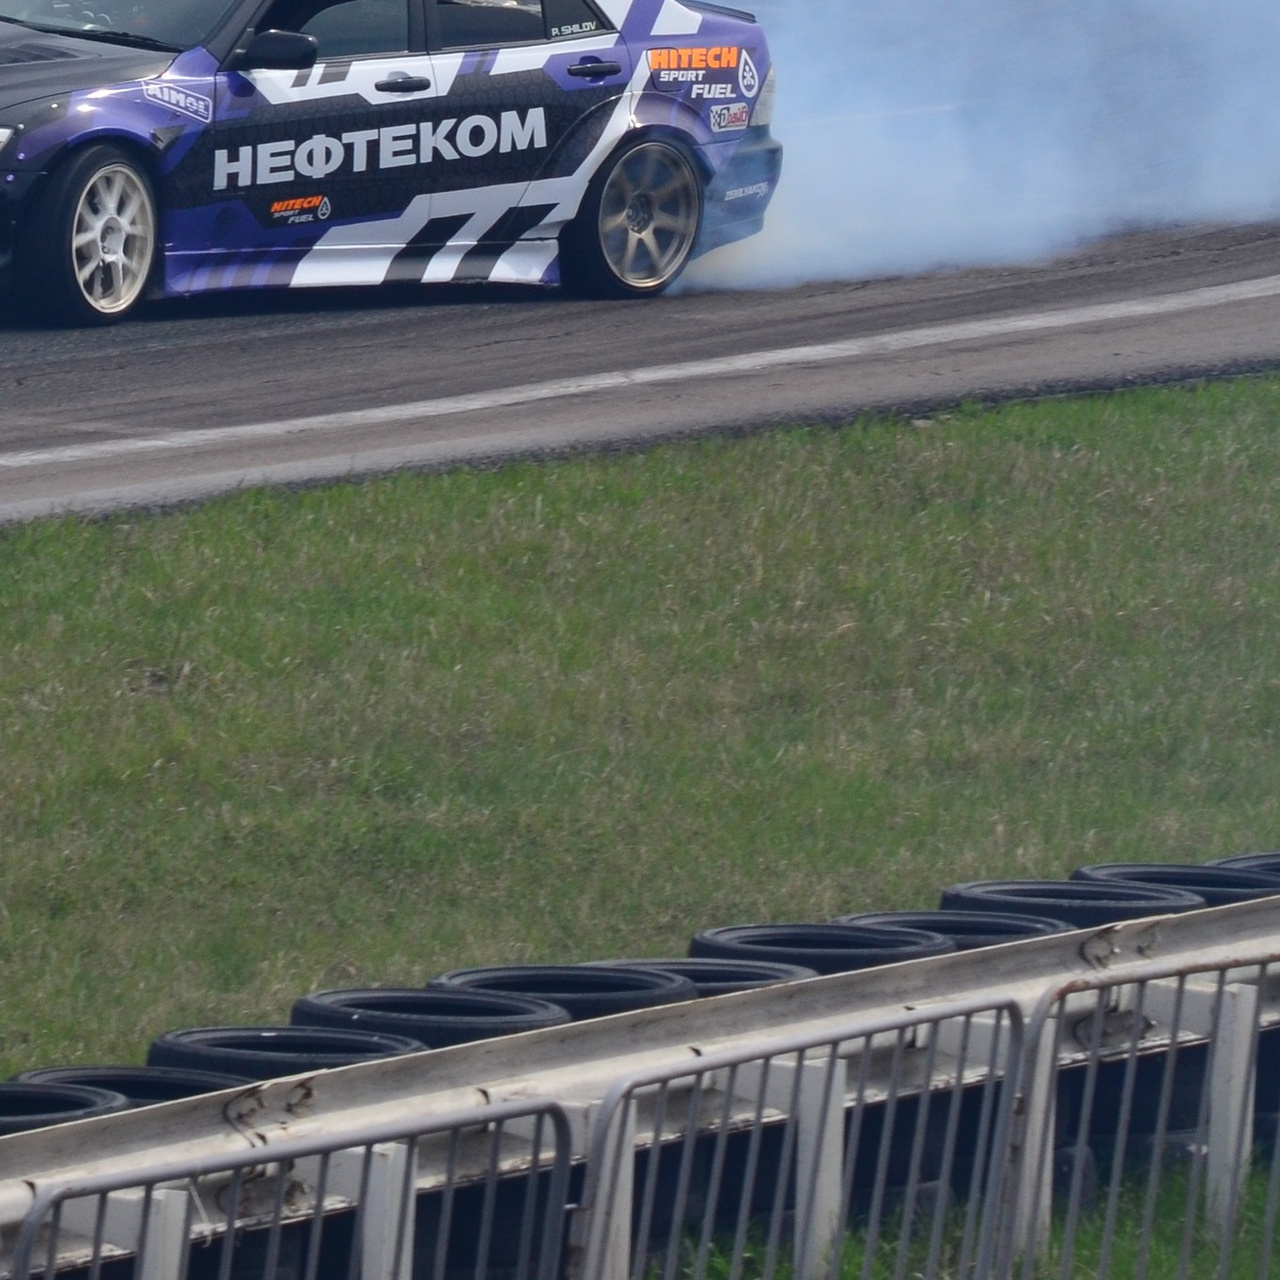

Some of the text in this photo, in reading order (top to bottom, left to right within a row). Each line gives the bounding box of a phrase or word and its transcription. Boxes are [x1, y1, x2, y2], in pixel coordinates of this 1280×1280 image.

[651, 46, 739, 70] HITECH
[659, 70, 706, 82] SPORT
[691, 83, 737, 99] FUEL
[147, 85, 209, 117] AIMOL
[213, 107, 547, 191] НЕФТЕКОМ
[271, 195, 323, 213] HITECH
[287, 213, 315, 224] FUEL
